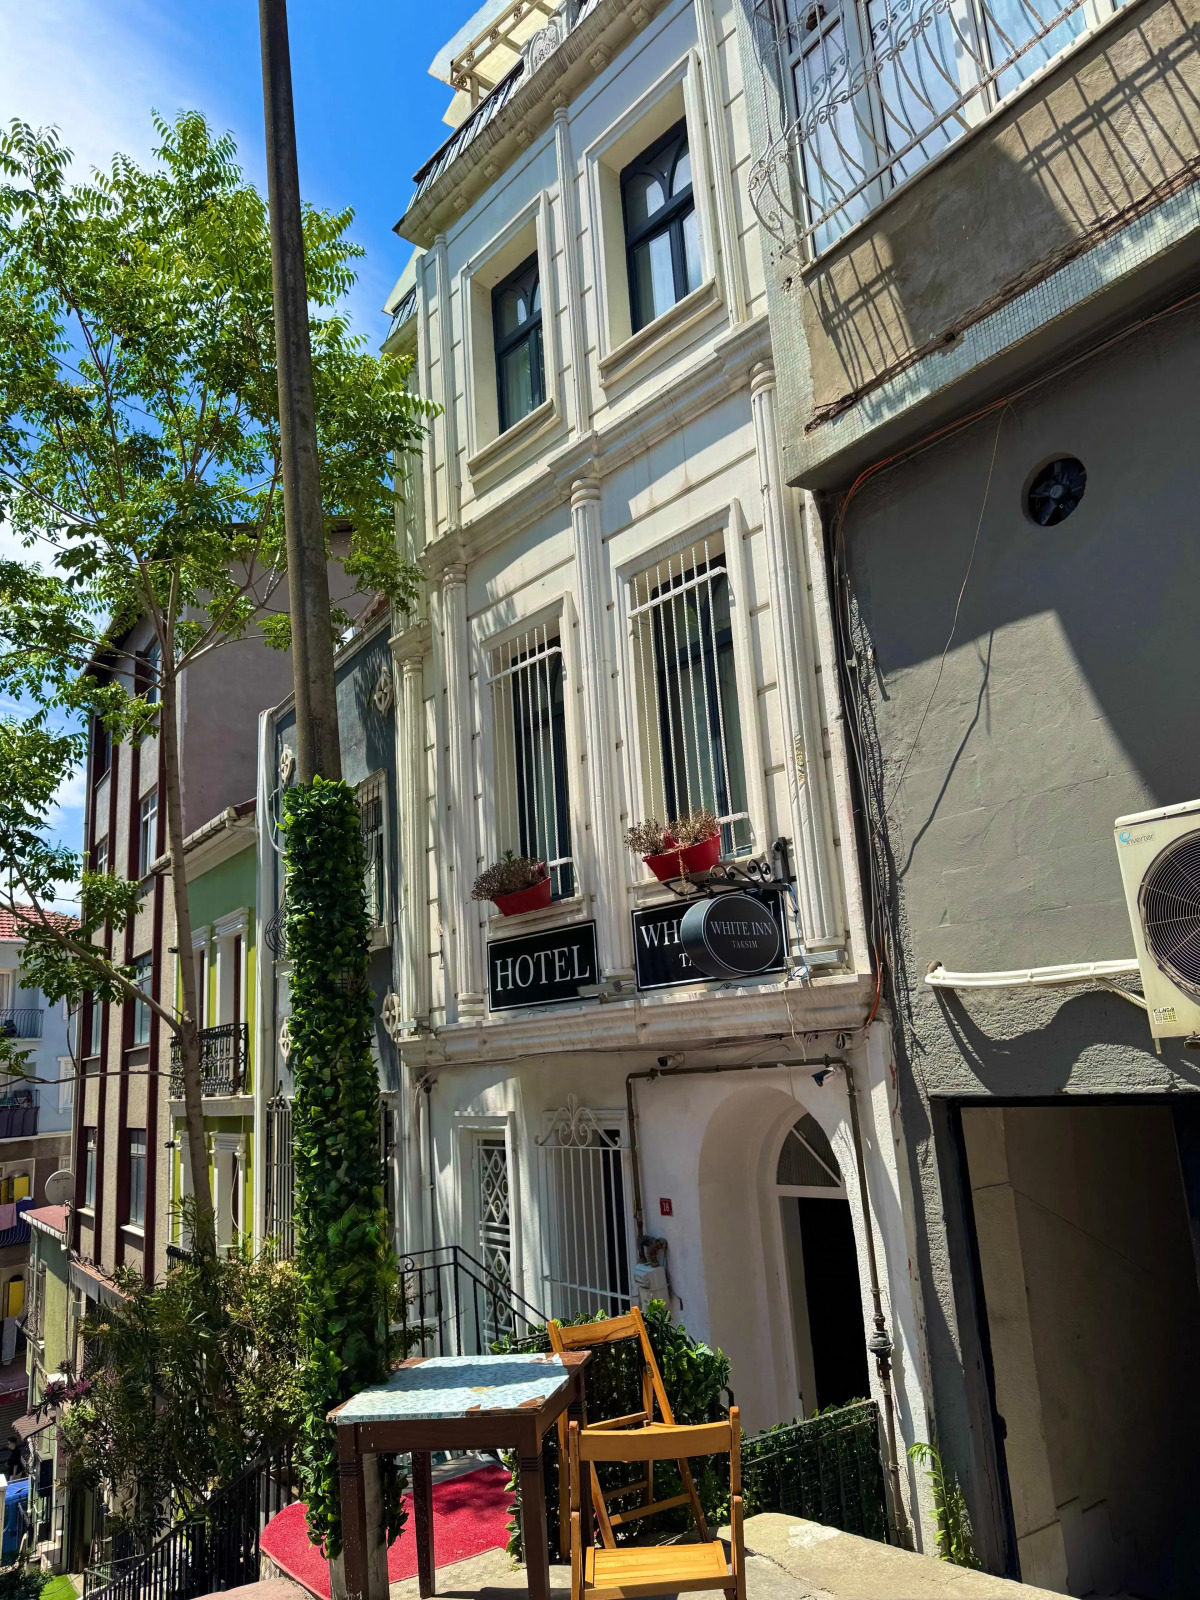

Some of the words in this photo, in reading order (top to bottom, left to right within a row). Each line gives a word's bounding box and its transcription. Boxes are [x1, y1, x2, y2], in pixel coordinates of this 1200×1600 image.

[710, 921, 750, 935] WHITE
[751, 921, 772, 935] INN
[732, 940, 758, 949] TAKSIM
[494, 944, 590, 992] HOTEL
